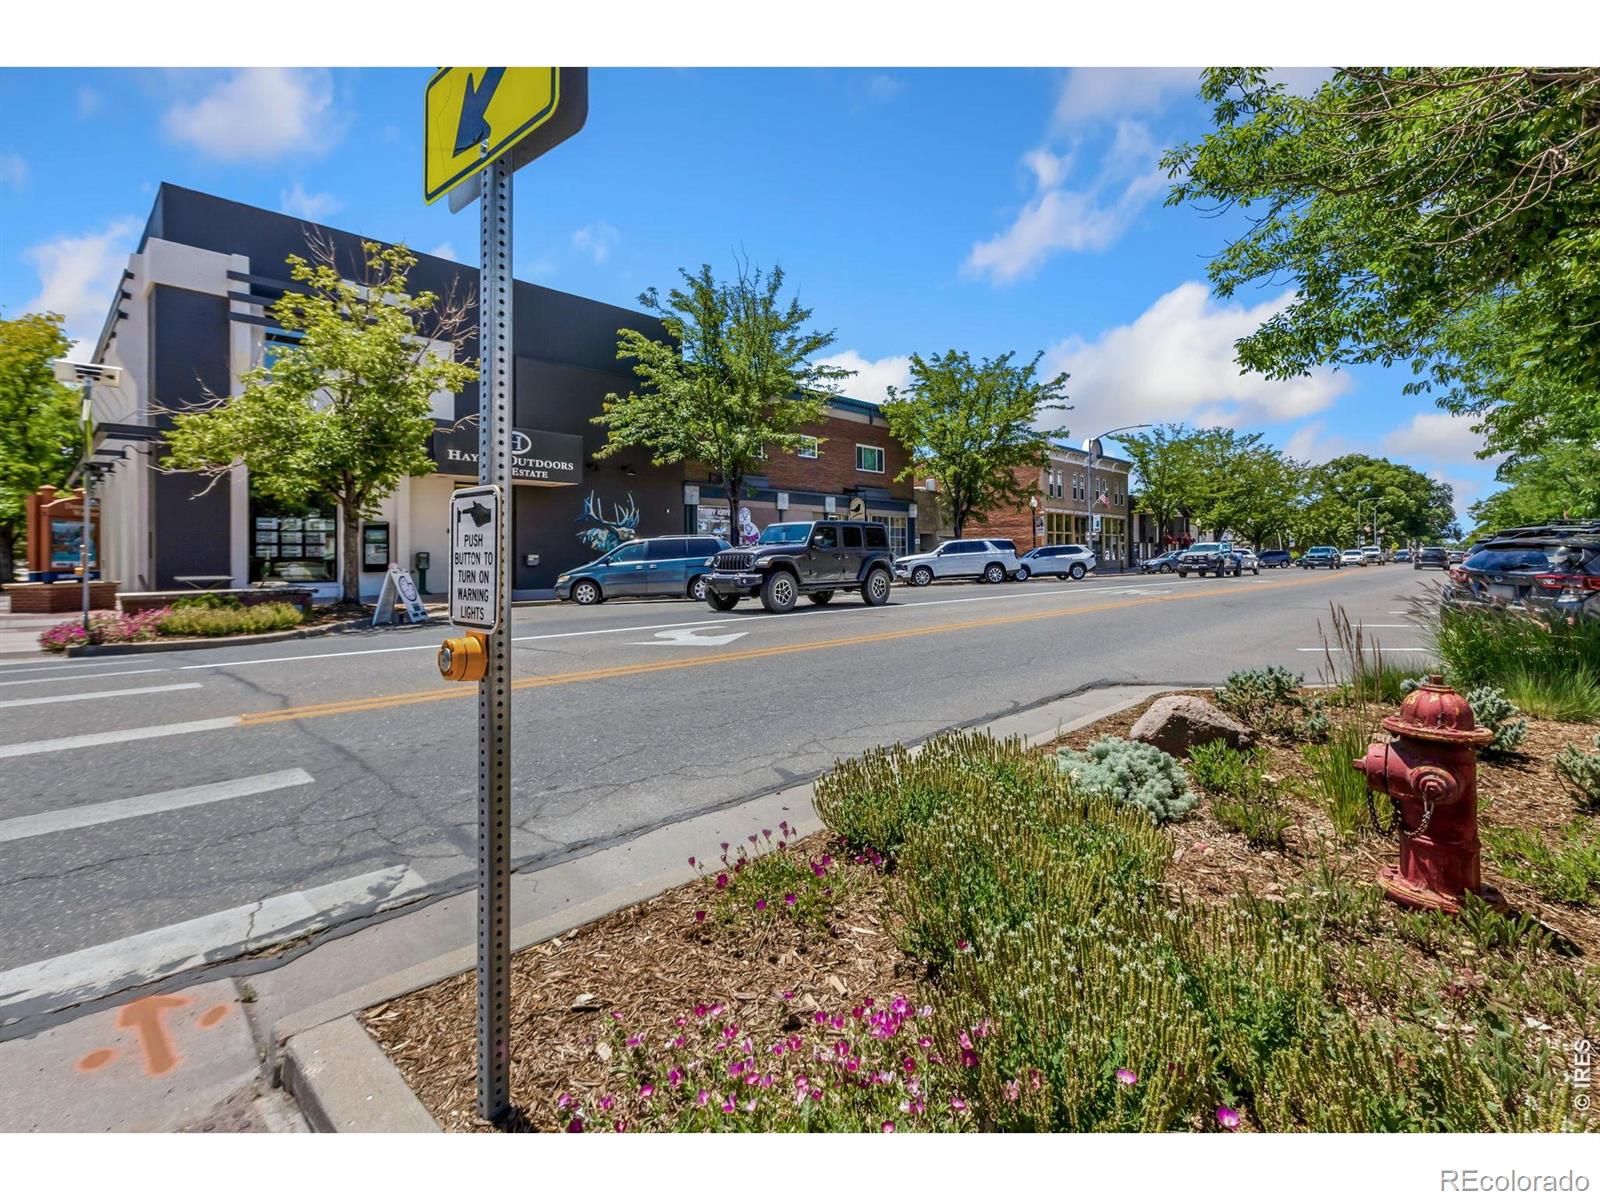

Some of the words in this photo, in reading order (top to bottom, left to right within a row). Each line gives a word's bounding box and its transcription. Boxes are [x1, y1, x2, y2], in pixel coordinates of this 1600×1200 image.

[448, 449, 480, 462] HAY
[512, 467, 548, 479] ESTATE
[464, 534, 483, 547] PUSH
[455, 552, 481, 565] BUTTON
[484, 552, 493, 565] TO
[458, 570, 476, 583] TURN
[479, 570, 489, 584] ON
[458, 588, 489, 602] WARNING
[461, 606, 484, 620] LIGHTS
